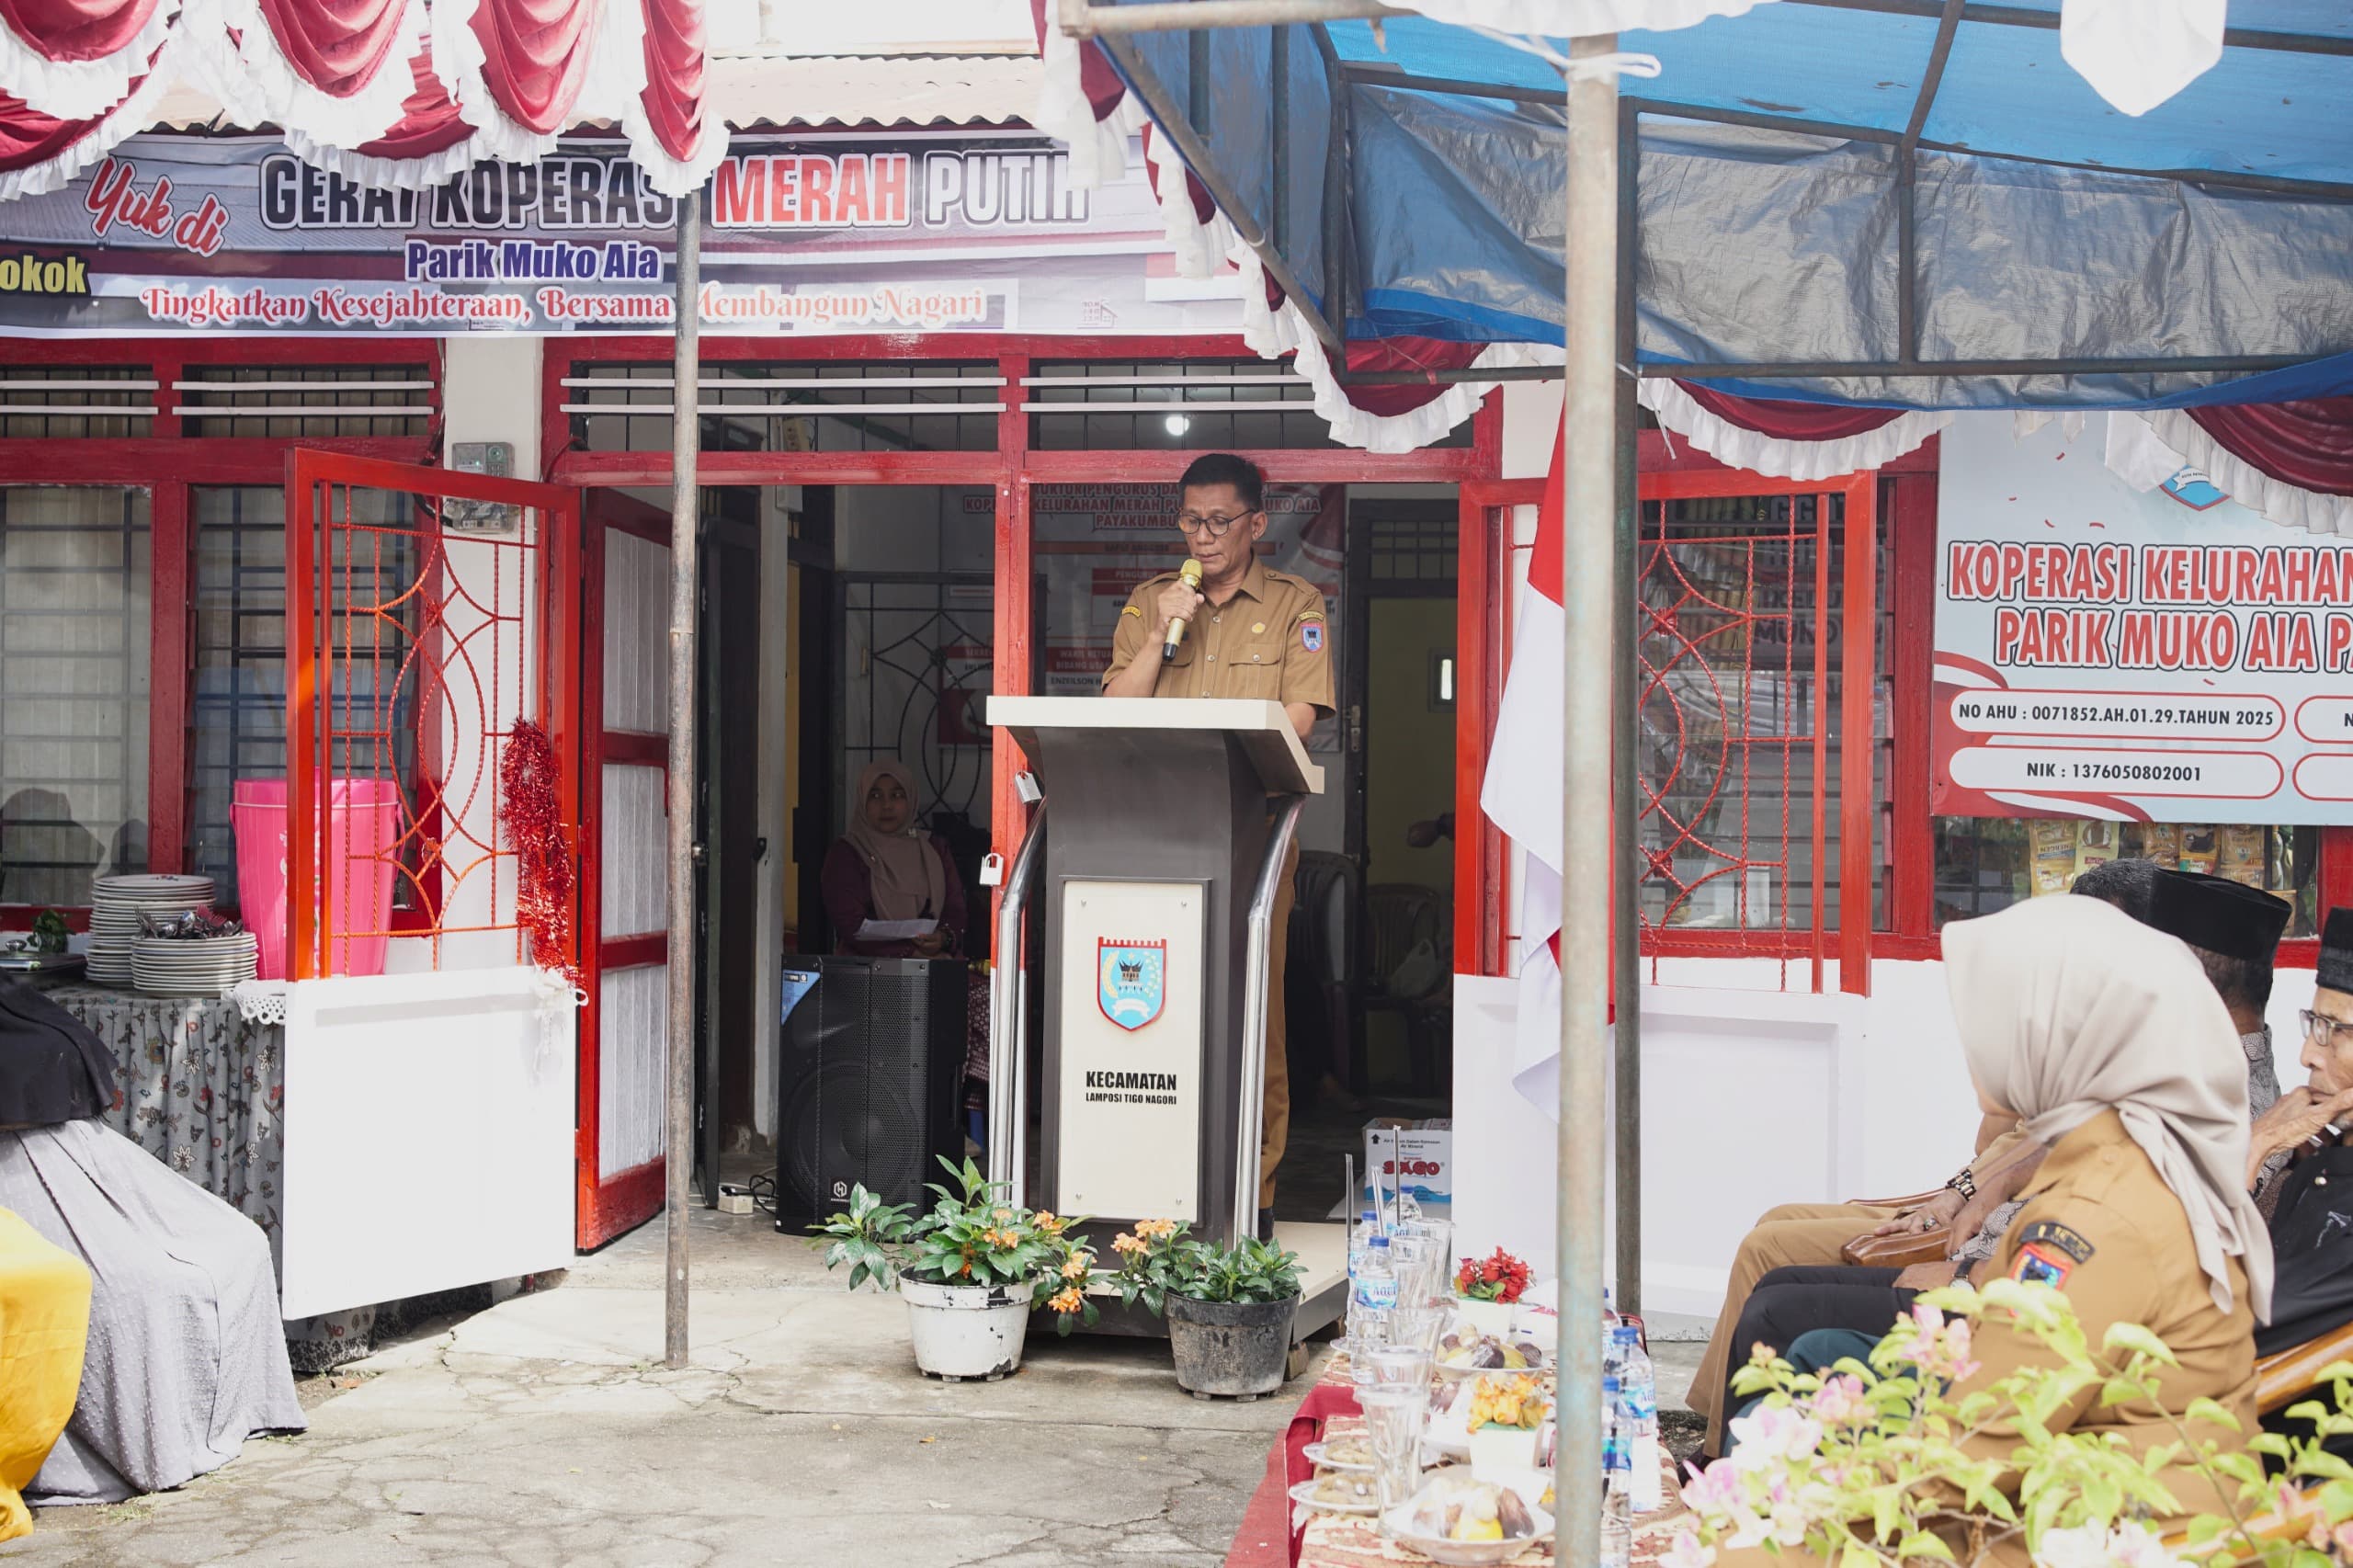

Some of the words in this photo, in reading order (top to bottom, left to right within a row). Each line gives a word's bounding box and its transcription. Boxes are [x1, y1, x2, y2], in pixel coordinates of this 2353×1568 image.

[435, 160, 675, 226] KOPERAS
[714, 155, 908, 224] MERAH
[927, 154, 1086, 222] PUTIH
[87, 157, 173, 234] Yuk
[175, 195, 227, 255] di
[0, 255, 87, 294] okok
[407, 243, 495, 278] Parik
[503, 243, 597, 278] Muko
[603, 243, 659, 278] Aia
[142, 288, 306, 323] Tingkatkan
[313, 288, 531, 325] Kesejahteraan,
[539, 289, 672, 318] Bersama
[878, 289, 983, 322] Nagari
[1113, 497, 1160, 511] MERAH
[1265, 497, 1293, 513] UKO
[1095, 514, 1178, 528] PAYAKUMBU
[1950, 544, 2130, 601] KOPERASI
[1997, 609, 2110, 665] PARIK
[2120, 613, 2235, 668] MUKO
[2246, 616, 2316, 668] AIA
[1959, 703, 1982, 719] NO
[1985, 704, 2018, 720] AHU
[2031, 705, 2230, 725] 0071852.AH.01.29.TAHUN
[2235, 710, 2274, 726] 2025
[2027, 762, 2056, 778] NIK
[2073, 763, 2201, 781] 1376050802001
[1086, 1070, 1177, 1091] KECAMATAN
[1086, 1092, 1122, 1103] LAMPOSI
[1124, 1093, 1143, 1104] TIGO
[1145, 1094, 1177, 1106] NAGORI
